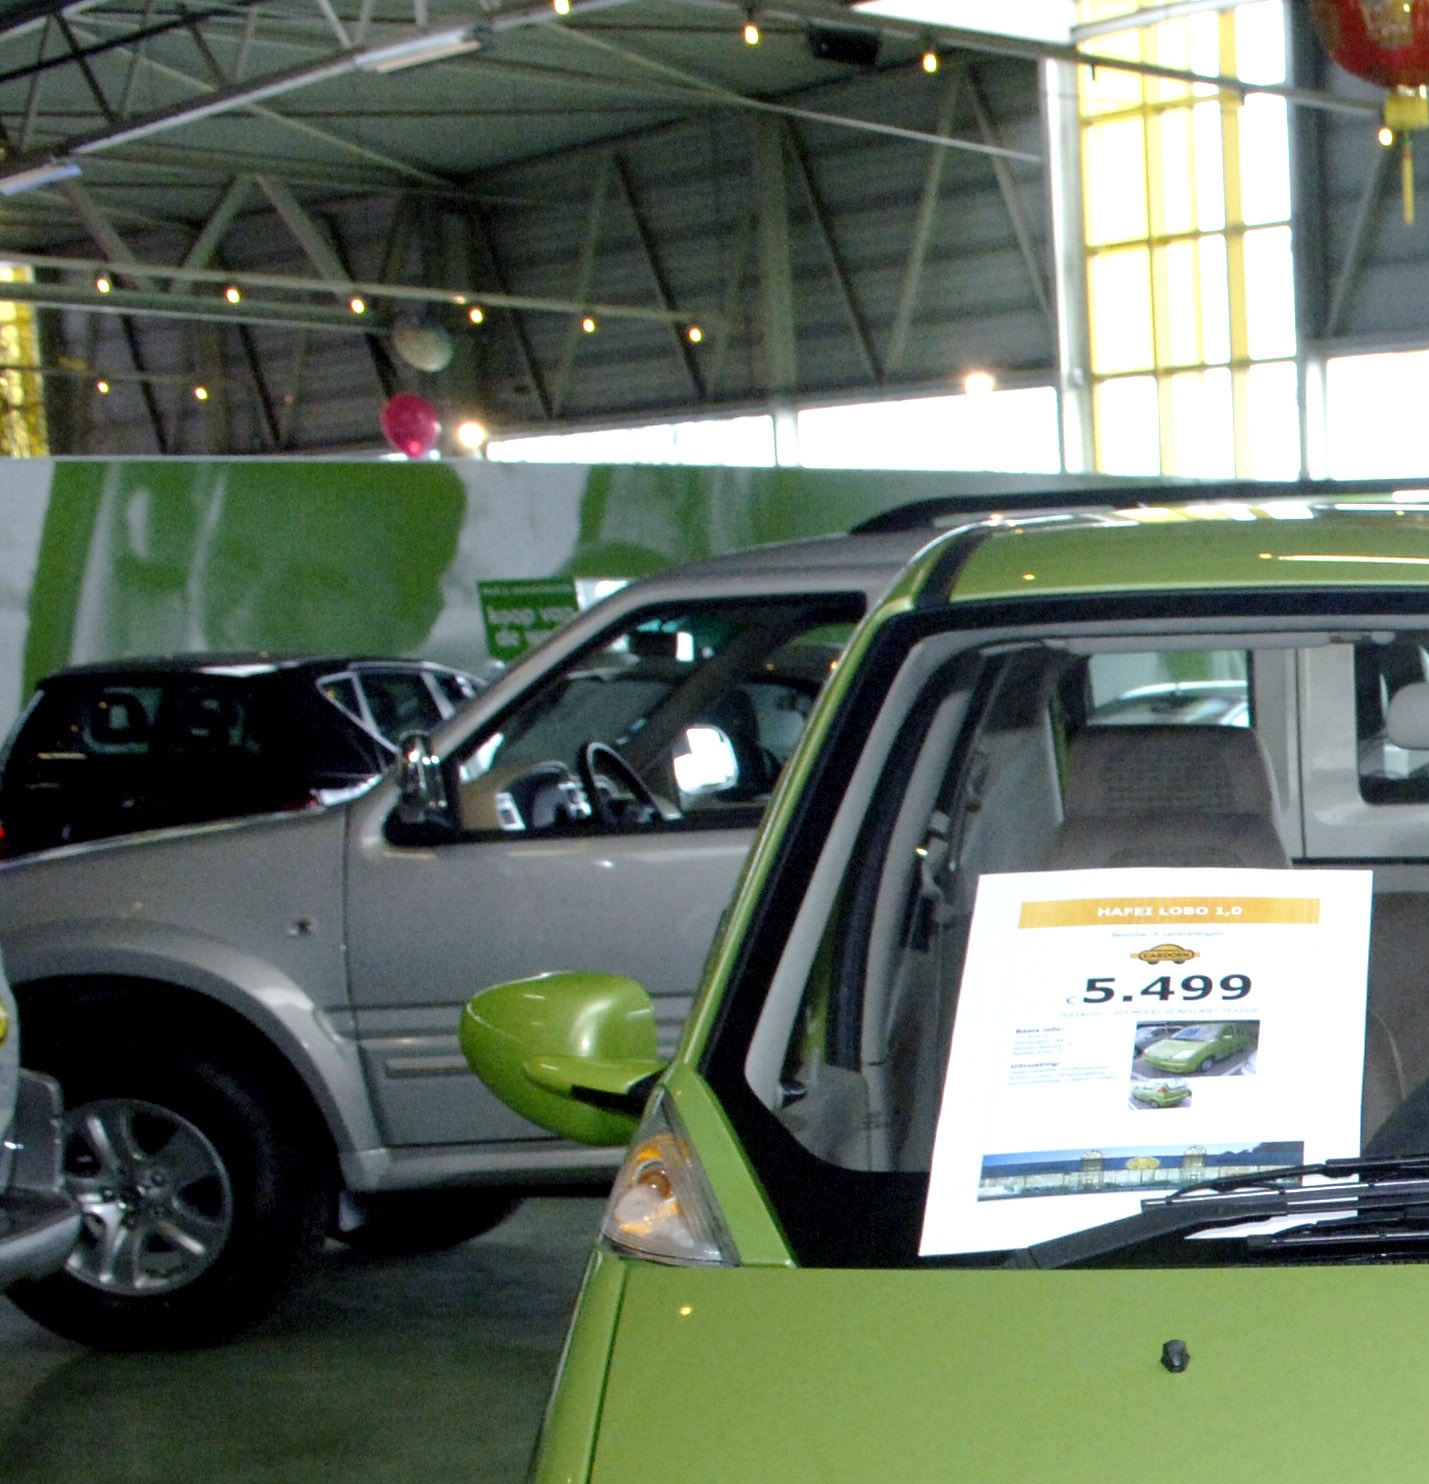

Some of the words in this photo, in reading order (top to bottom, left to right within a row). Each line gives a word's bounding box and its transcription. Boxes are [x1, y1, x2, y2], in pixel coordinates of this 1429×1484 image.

[1096, 906, 1154, 917] HAFEI
[1159, 906, 1209, 916] LOBO
[1082, 973, 1253, 1005] 5.499
